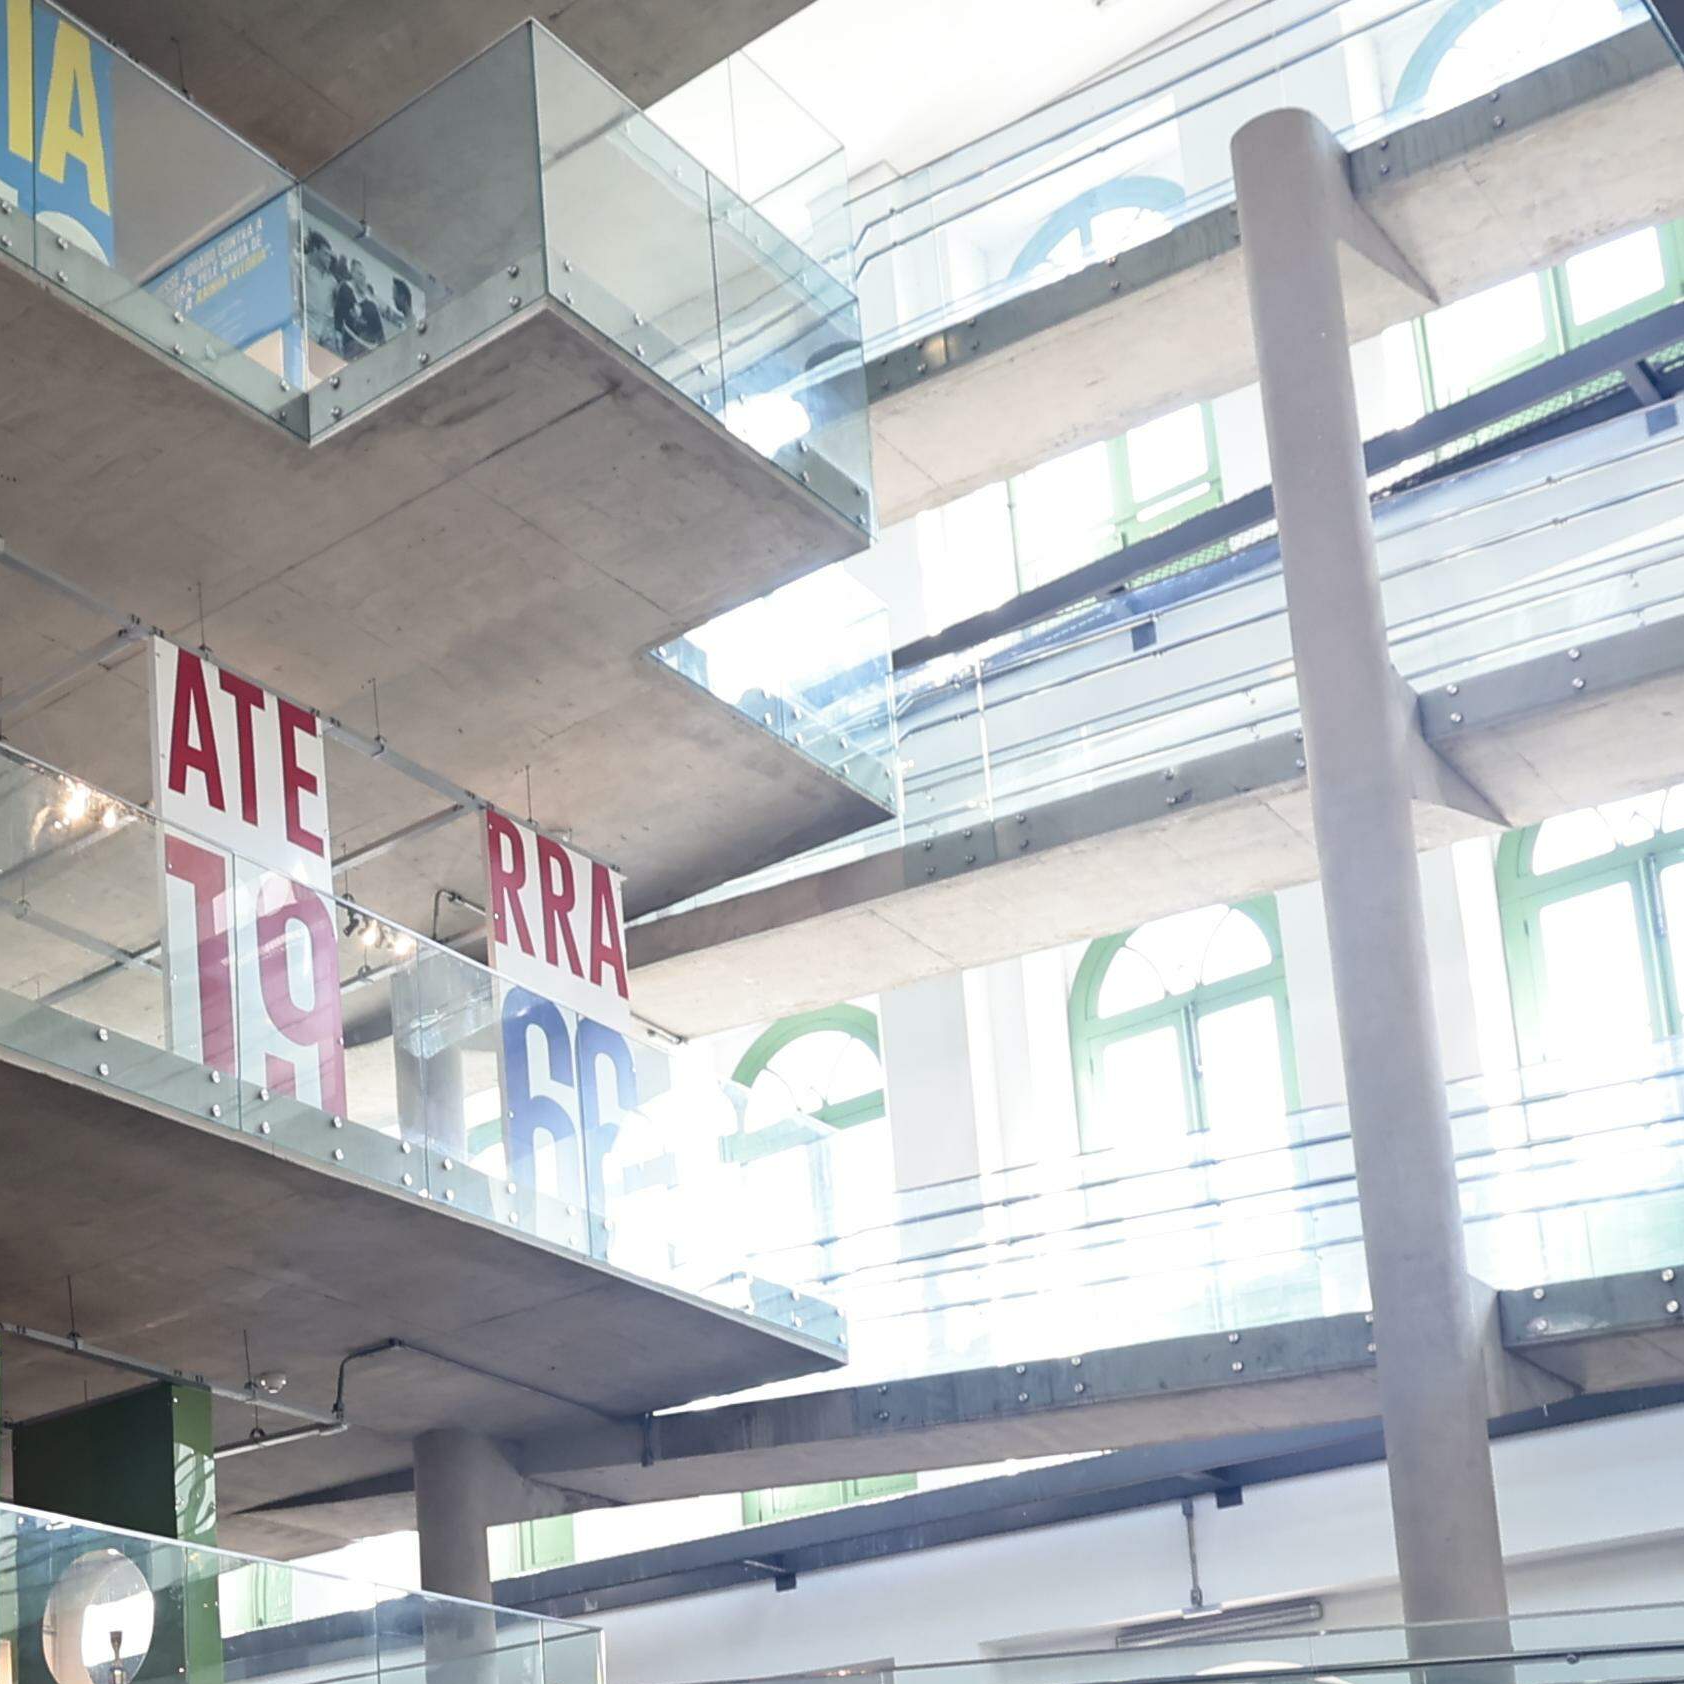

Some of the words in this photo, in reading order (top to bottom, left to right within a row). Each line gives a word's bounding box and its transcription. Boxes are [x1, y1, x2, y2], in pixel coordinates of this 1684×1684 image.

[167, 647, 325, 859] ATE
[164, 834, 347, 1120] 19
[486, 810, 629, 1000] RRA
